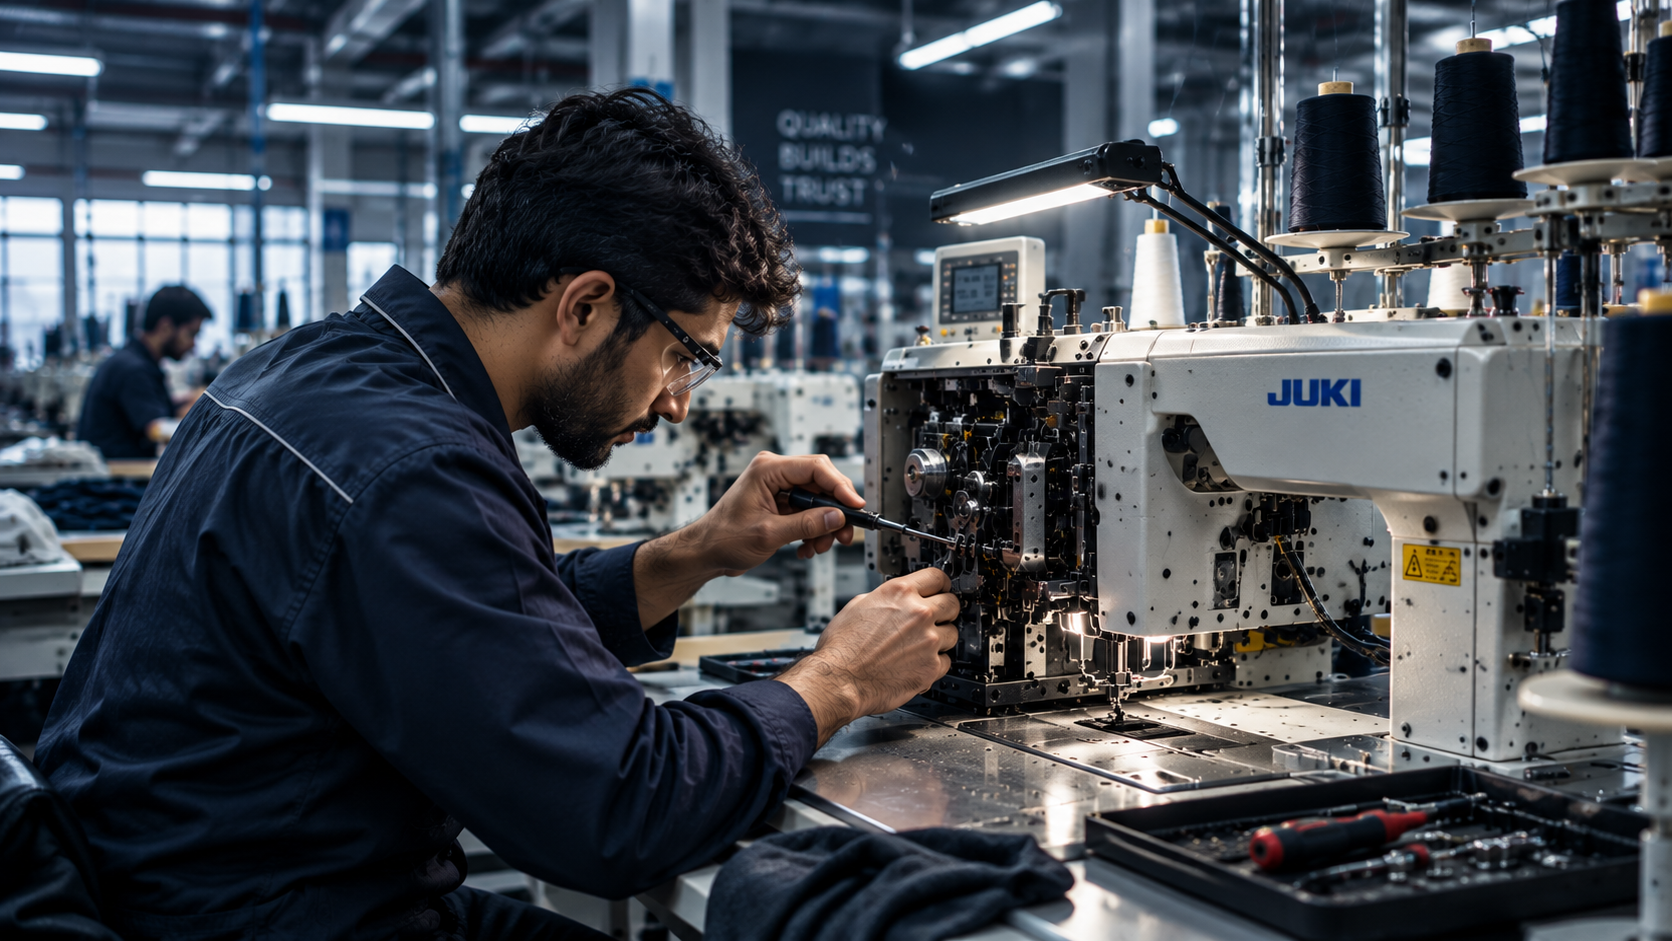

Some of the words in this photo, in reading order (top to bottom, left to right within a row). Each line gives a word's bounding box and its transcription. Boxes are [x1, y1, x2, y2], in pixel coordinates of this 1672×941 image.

[778, 110, 886, 141] QUALITY
[779, 143, 876, 173] BUILDS
[781, 175, 866, 206] TRUST
[1267, 379, 1361, 407] JUKI
